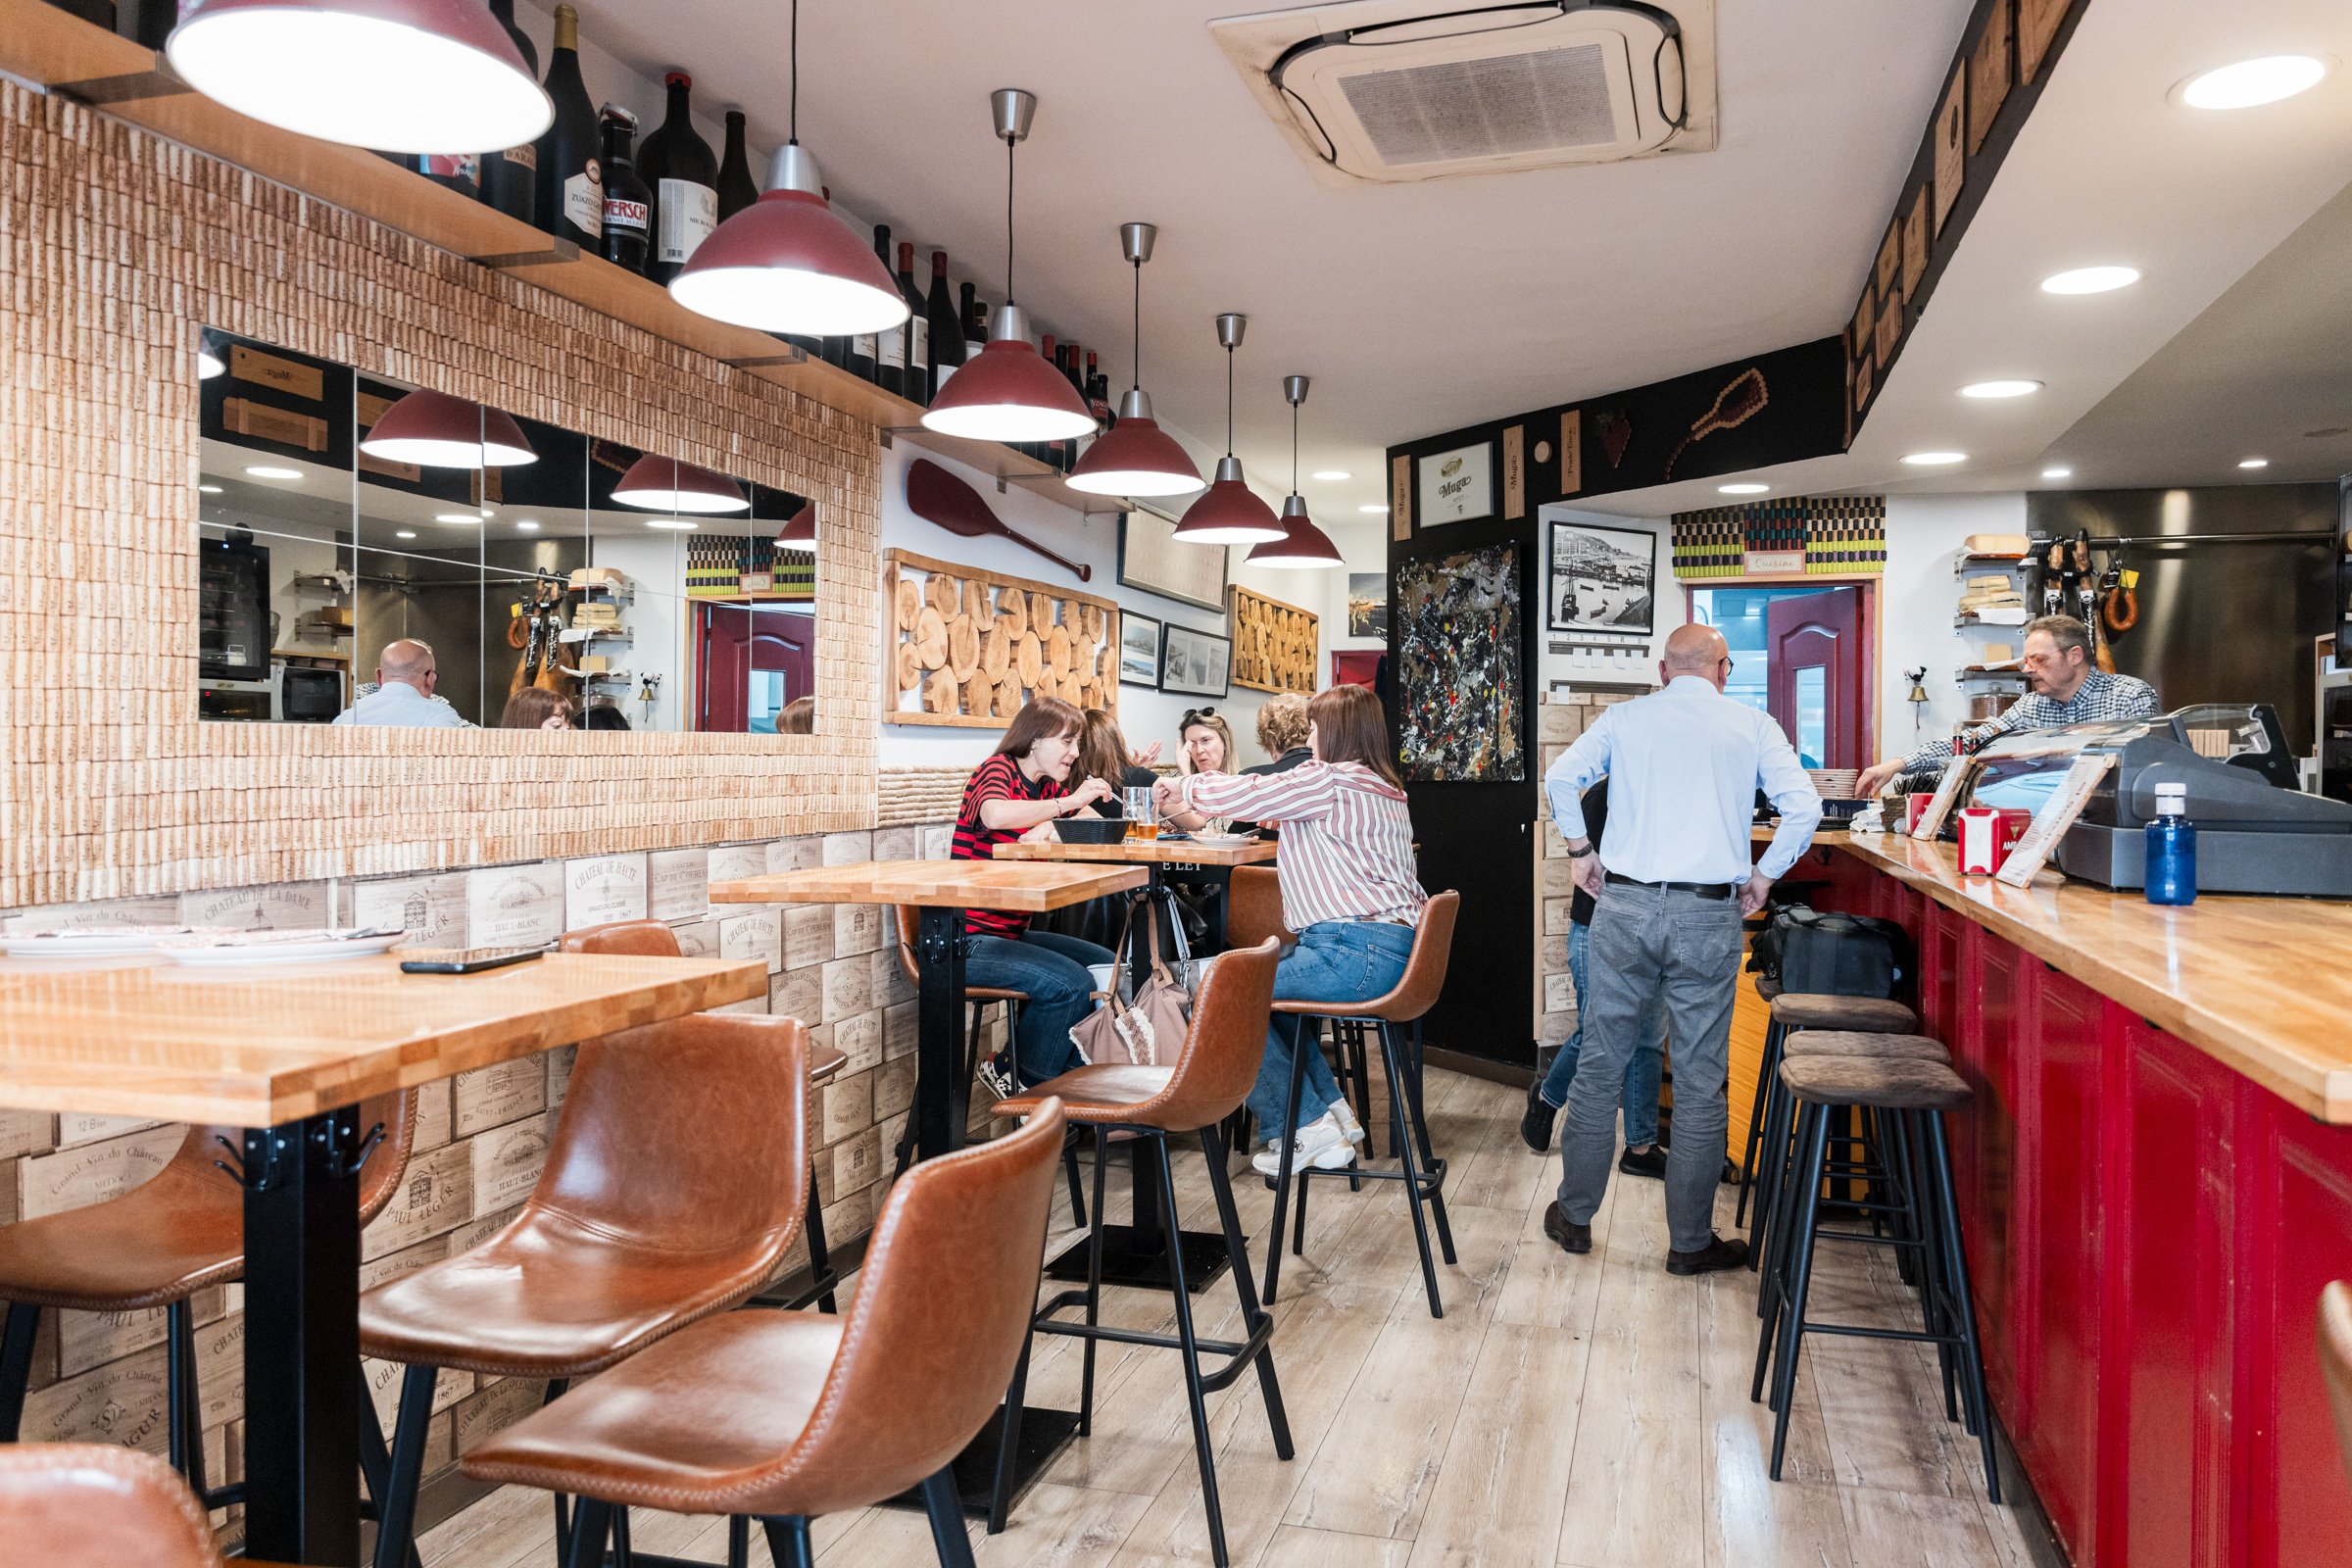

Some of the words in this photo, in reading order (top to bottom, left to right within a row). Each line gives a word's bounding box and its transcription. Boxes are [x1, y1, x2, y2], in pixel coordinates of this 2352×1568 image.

[571, 194, 593, 206] ZUAZO
[1438, 475, 1472, 499] Muga
[1755, 558, 1796, 568] Cuisine
[574, 861, 604, 890] CHATEAU
[606, 860, 614, 874] DE
[616, 861, 638, 883] HAUTE
[204, 889, 250, 921] CHATEAU
[269, 888, 281, 903] LA
[285, 890, 313, 911] DAME
[415, 913, 451, 944] LEGER
[495, 917, 541, 932] HAUT-BLANC
[726, 919, 749, 946] CHATEAU
[758, 918, 775, 937] HAUTE
[838, 1020, 857, 1045] CHATEAU
[51, 1163, 82, 1196] Grand
[84, 1151, 105, 1166] Vin
[108, 1147, 122, 1159] du
[126, 1146, 164, 1166] Château
[386, 1206, 414, 1225] PAUL
[417, 1185, 455, 1221] LEGER
[53, 1394, 82, 1427] Grand
[86, 1379, 105, 1395] Vin
[109, 1372, 122, 1386] du
[126, 1370, 163, 1385] Château
[437, 1386, 454, 1402] 1867
[458, 1393, 491, 1437] CHATEAU
